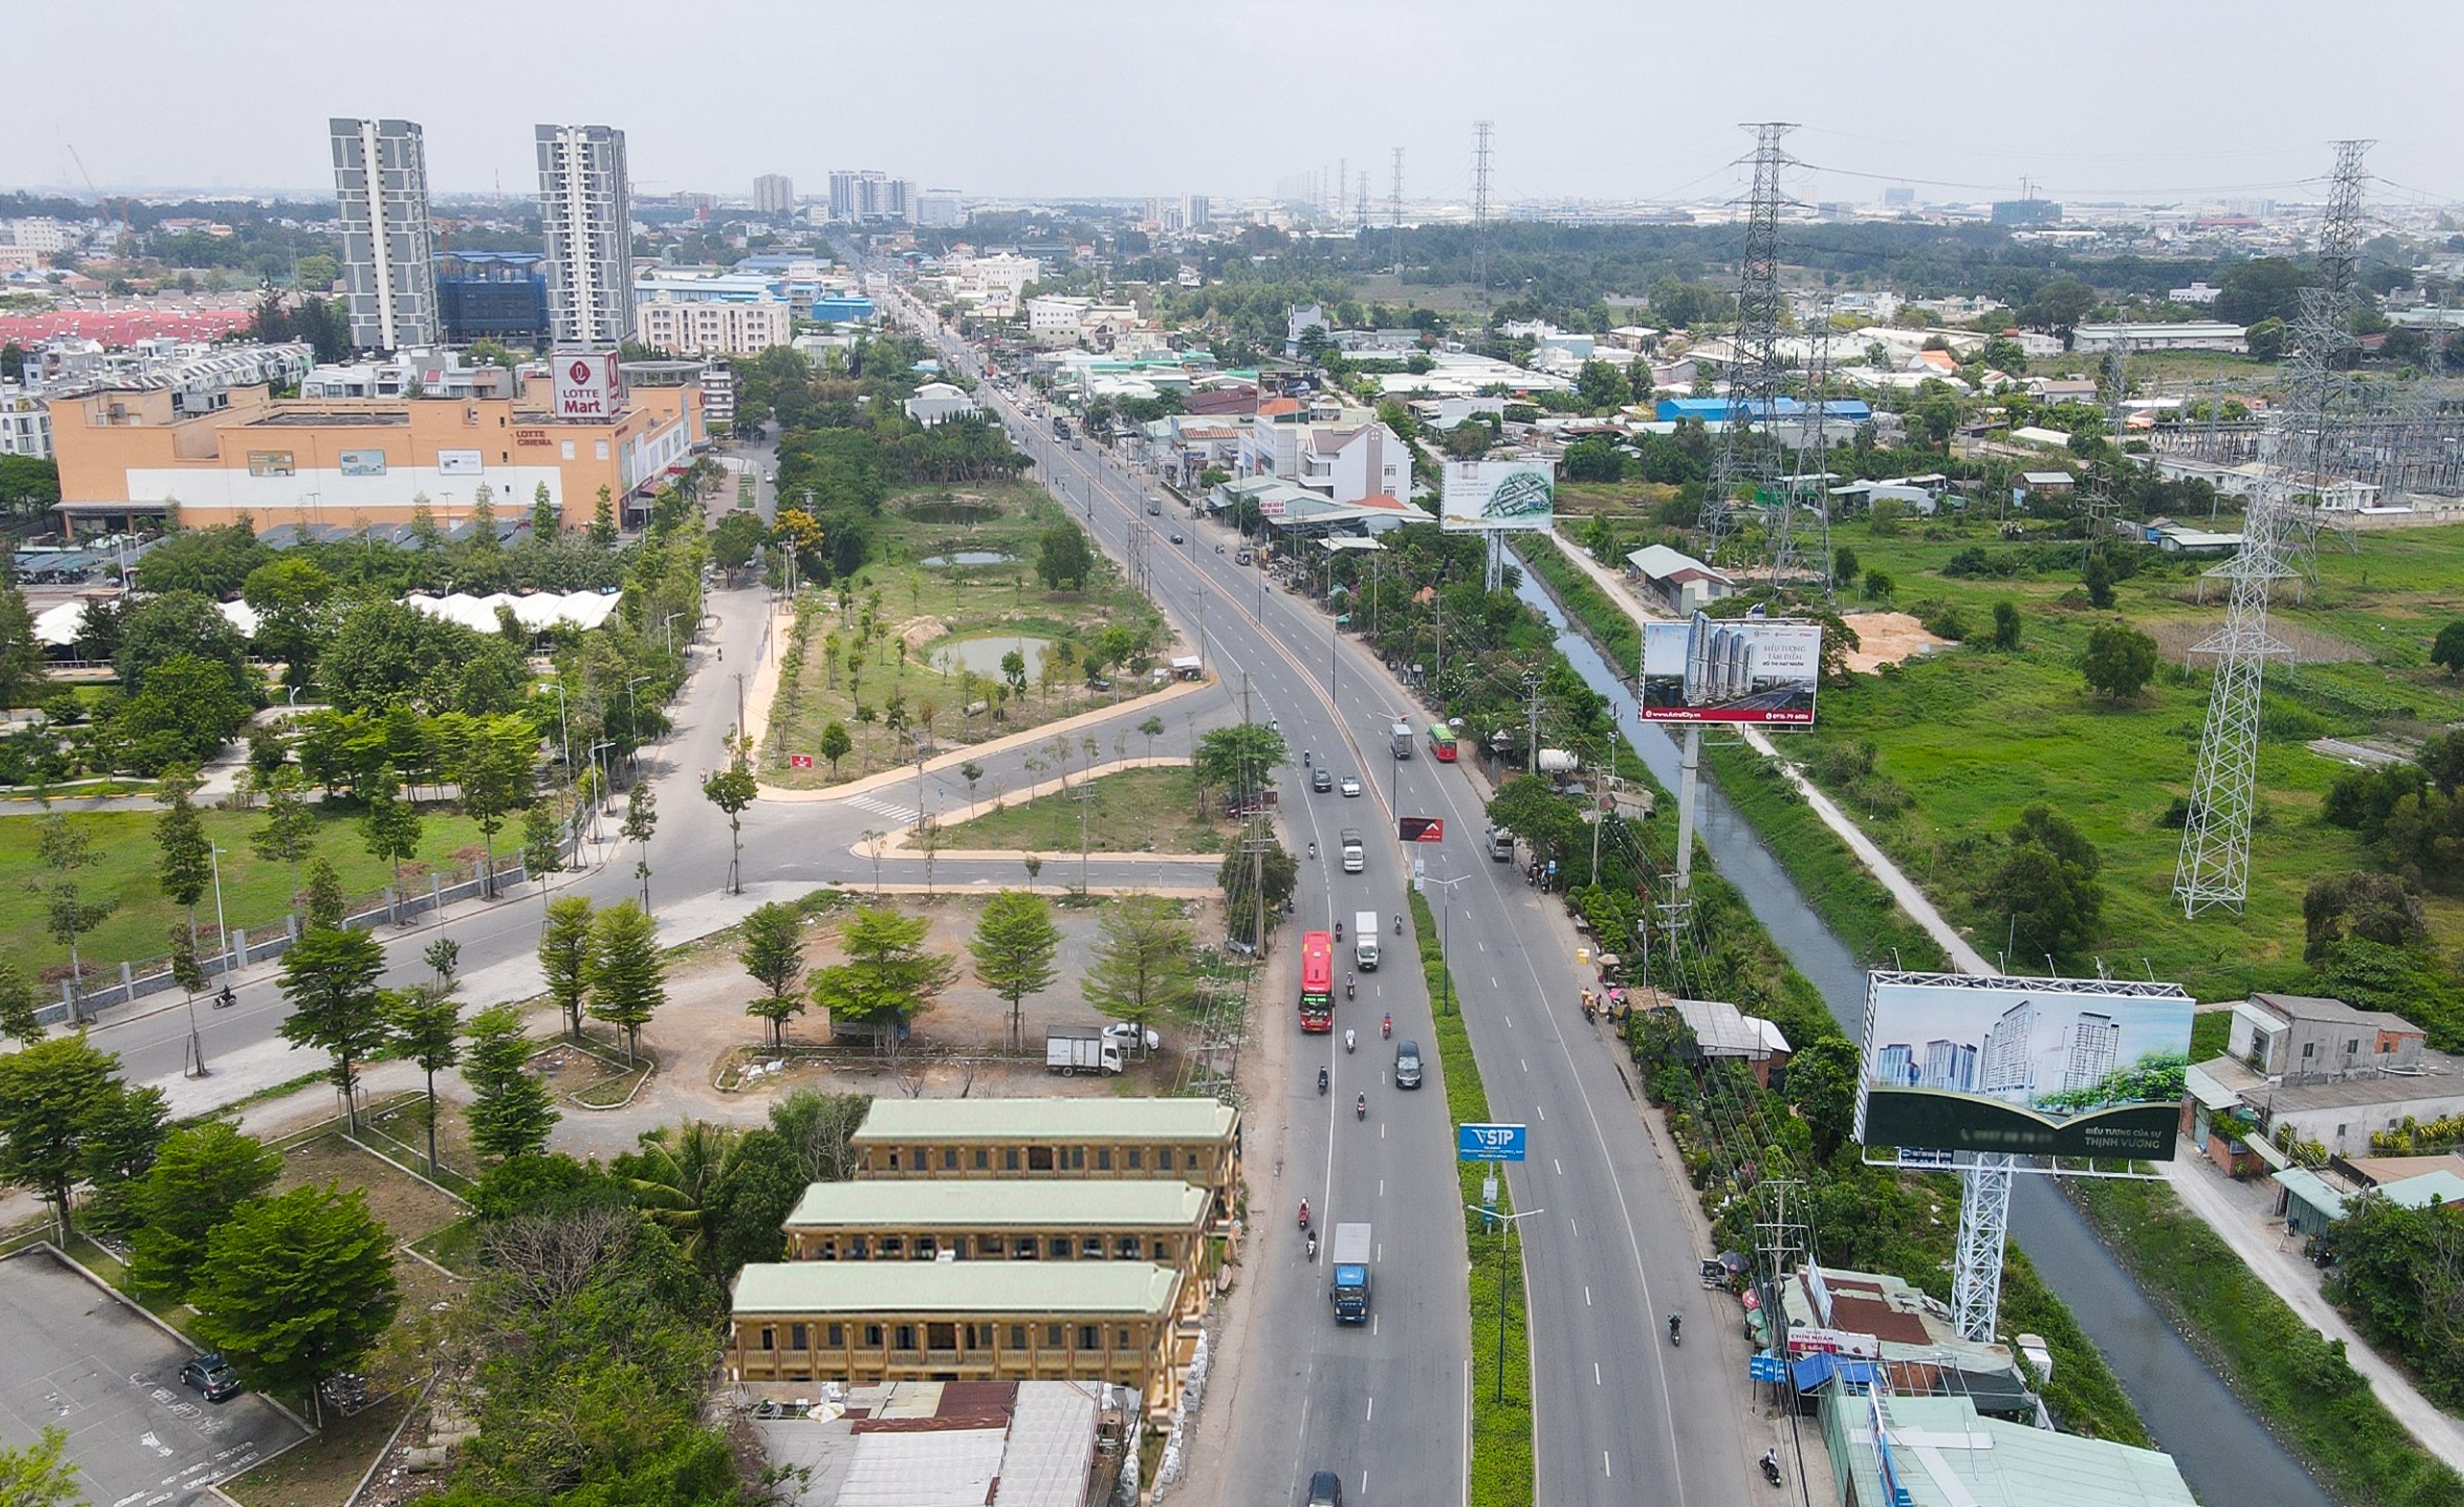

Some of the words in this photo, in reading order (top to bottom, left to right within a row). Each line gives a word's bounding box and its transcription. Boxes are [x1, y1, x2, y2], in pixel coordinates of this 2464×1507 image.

[563, 389, 600, 398] LOTTE
[564, 400, 602, 413] Mart
[1471, 1129, 1515, 1145] VSIP
[2084, 1137, 2118, 1148] THỊNH
[2120, 1137, 2161, 1150] VƯỢNG
